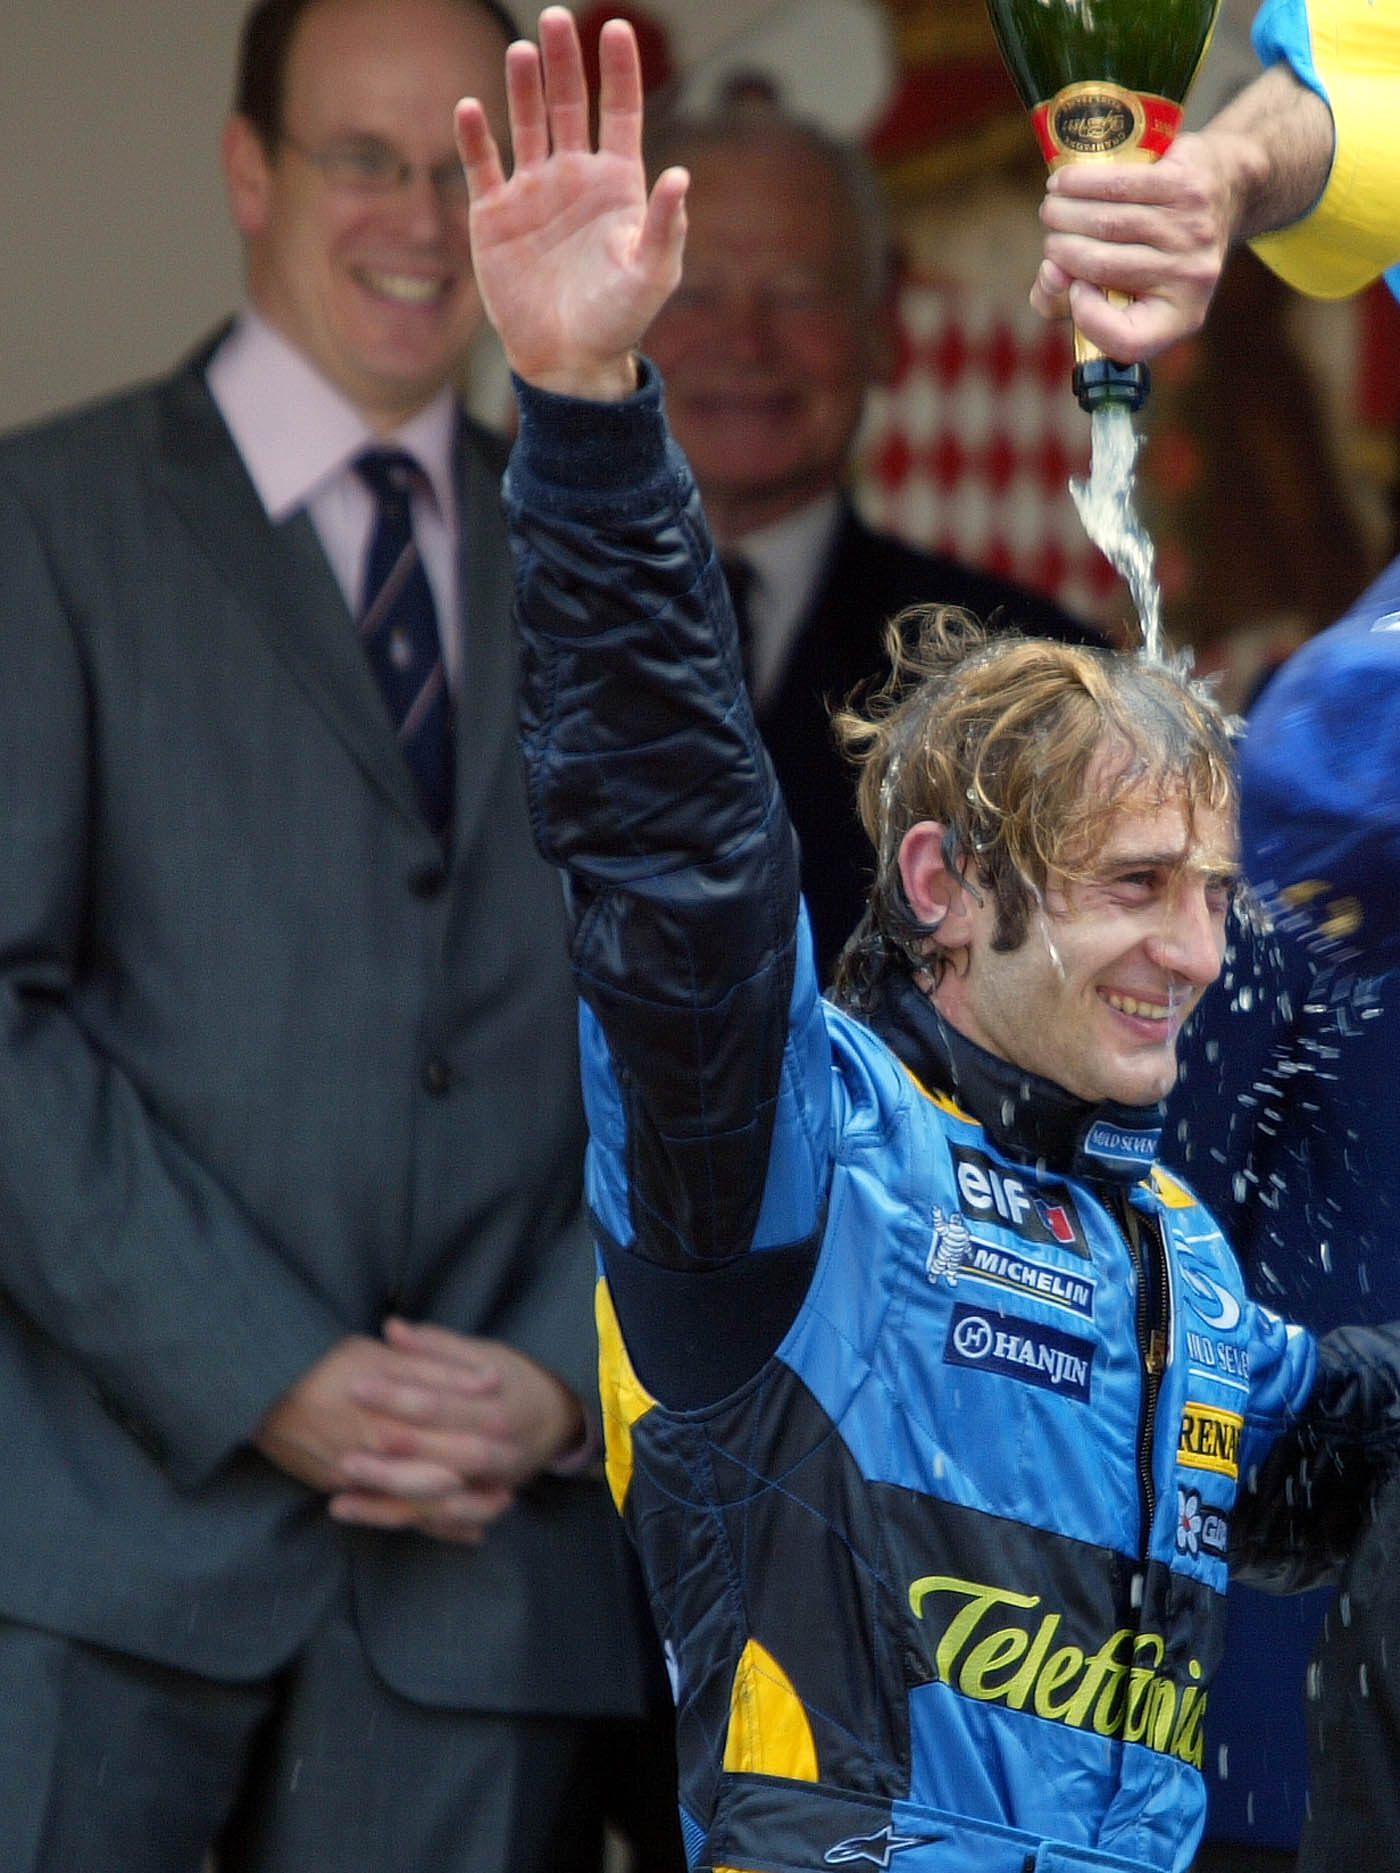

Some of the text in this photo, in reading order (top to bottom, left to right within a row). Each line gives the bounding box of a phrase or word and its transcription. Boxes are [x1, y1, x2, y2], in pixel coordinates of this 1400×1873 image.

[958, 1161, 1031, 1225] elf
[973, 1249, 1090, 1306] MICHELIN
[993, 1332, 1088, 1386] HANJIN
